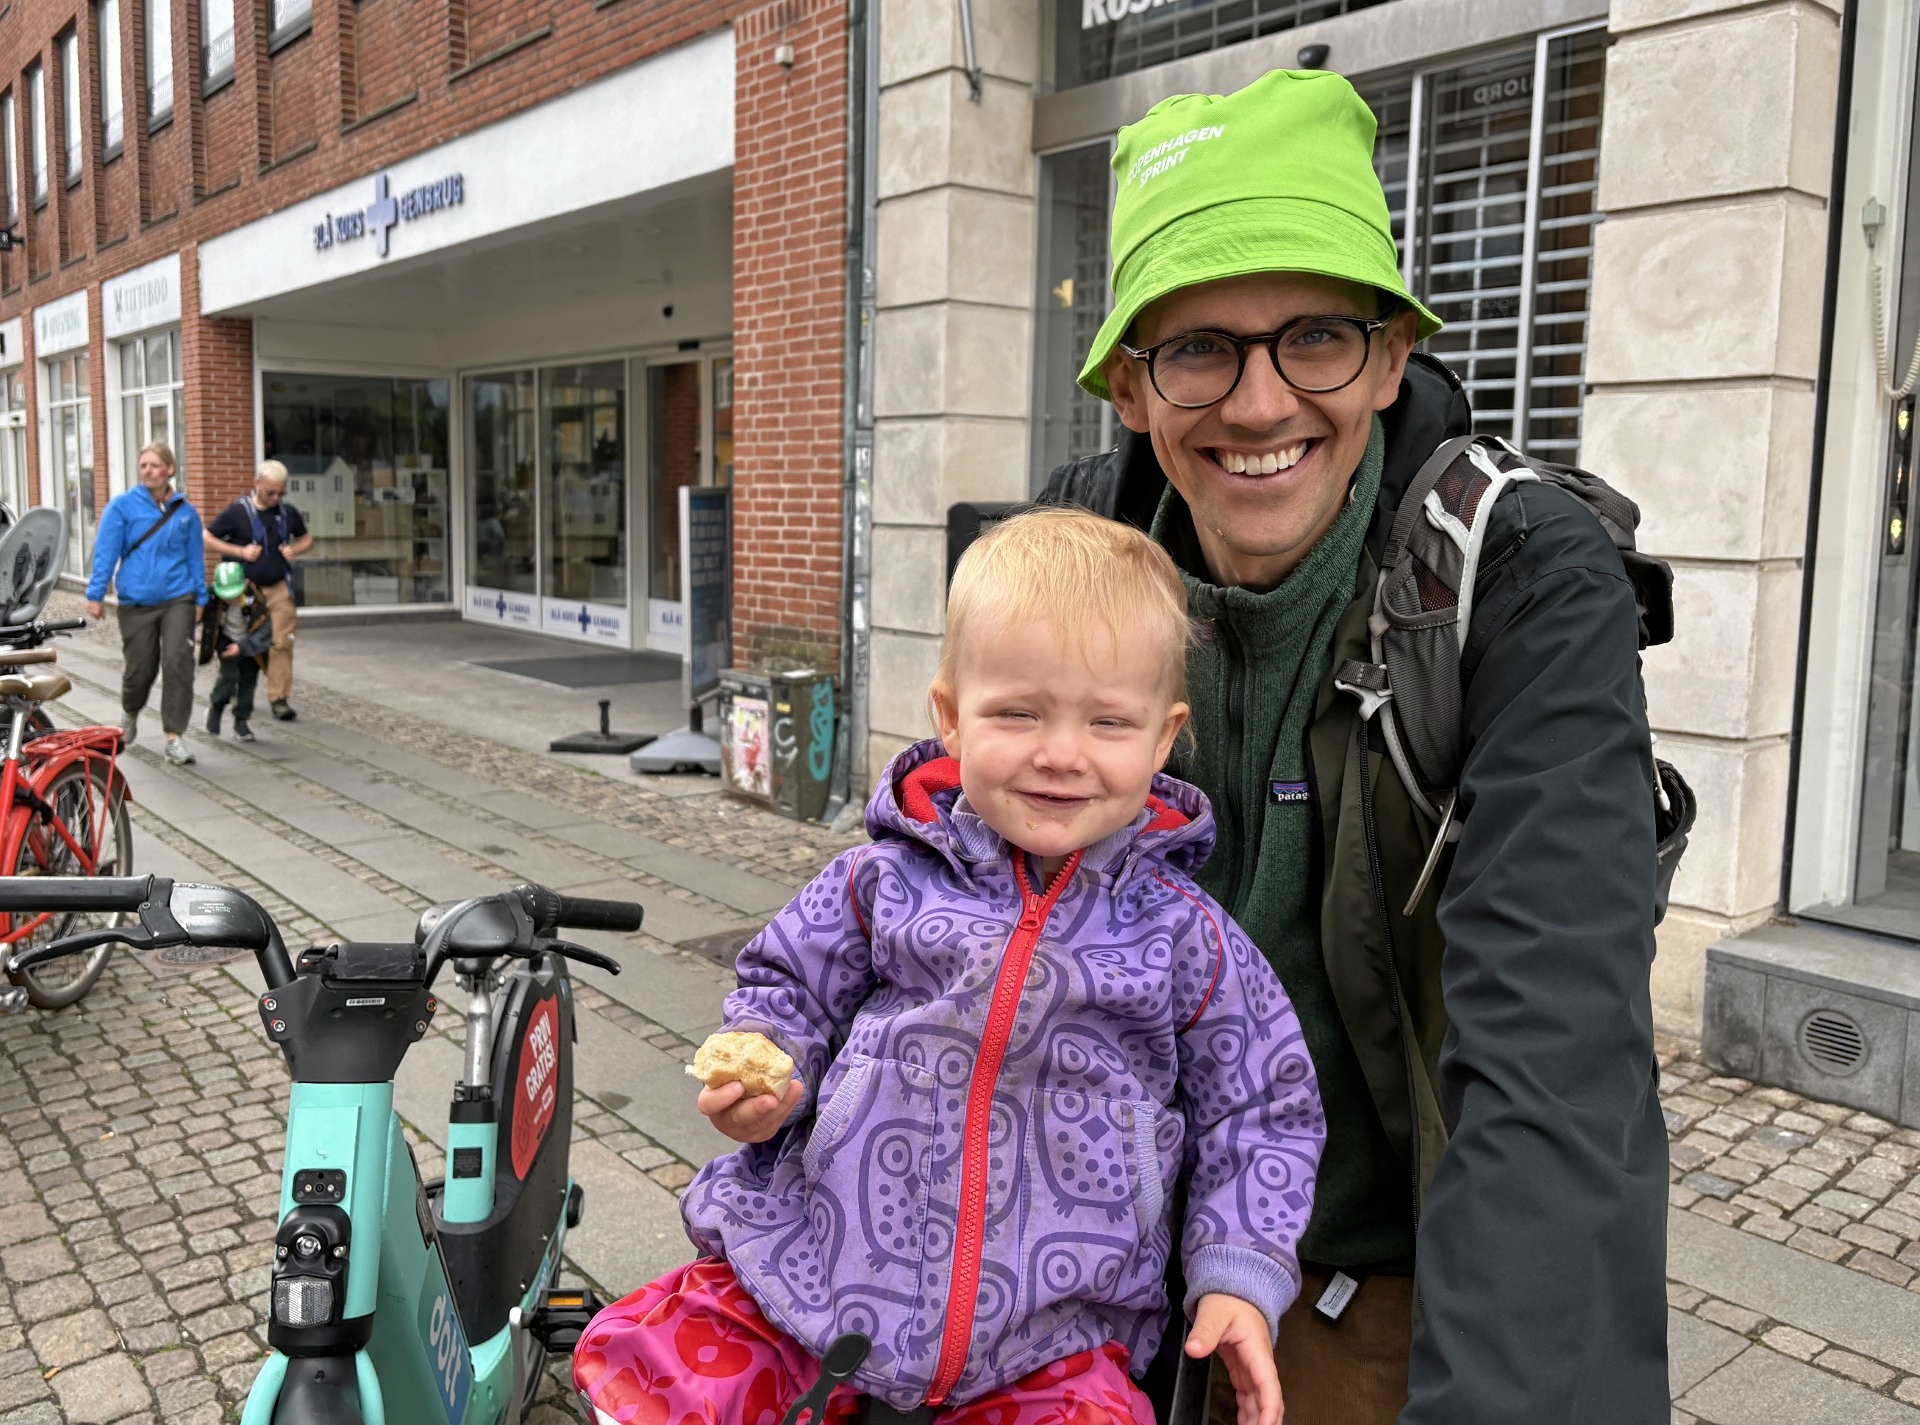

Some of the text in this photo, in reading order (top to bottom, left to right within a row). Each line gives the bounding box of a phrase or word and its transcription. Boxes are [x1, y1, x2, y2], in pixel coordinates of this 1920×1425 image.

[1127, 125, 1225, 186] COPENHAGEN
[1139, 147, 1190, 190] SPRINT
[401, 172, 464, 222] GENBRUG
[1278, 791, 1310, 801] patag
[529, 1011, 552, 1058] PRØV
[525, 1040, 556, 1102] GRATIS!
[430, 1293, 462, 1408] dott
